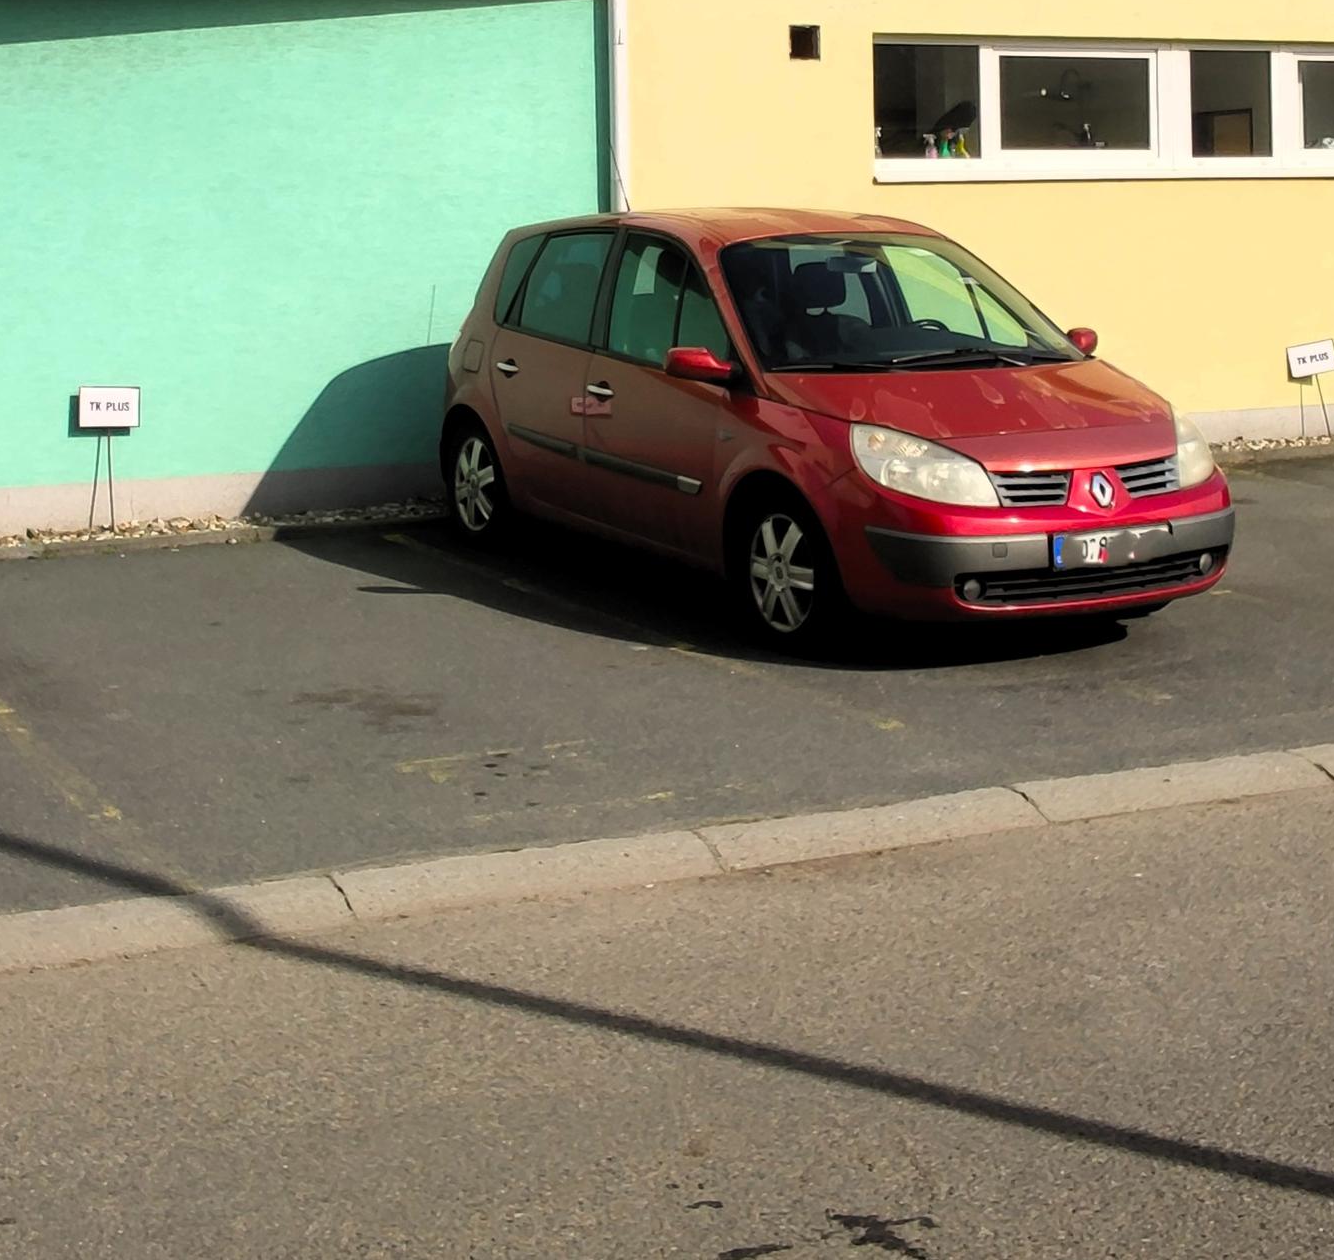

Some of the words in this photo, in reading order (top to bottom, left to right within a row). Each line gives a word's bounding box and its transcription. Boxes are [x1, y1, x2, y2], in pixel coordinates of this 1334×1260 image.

[1296, 356, 1307, 365] TK
[1309, 352, 1330, 363] PLUS
[89, 401, 102, 412] TK
[105, 401, 130, 412] PLUS
